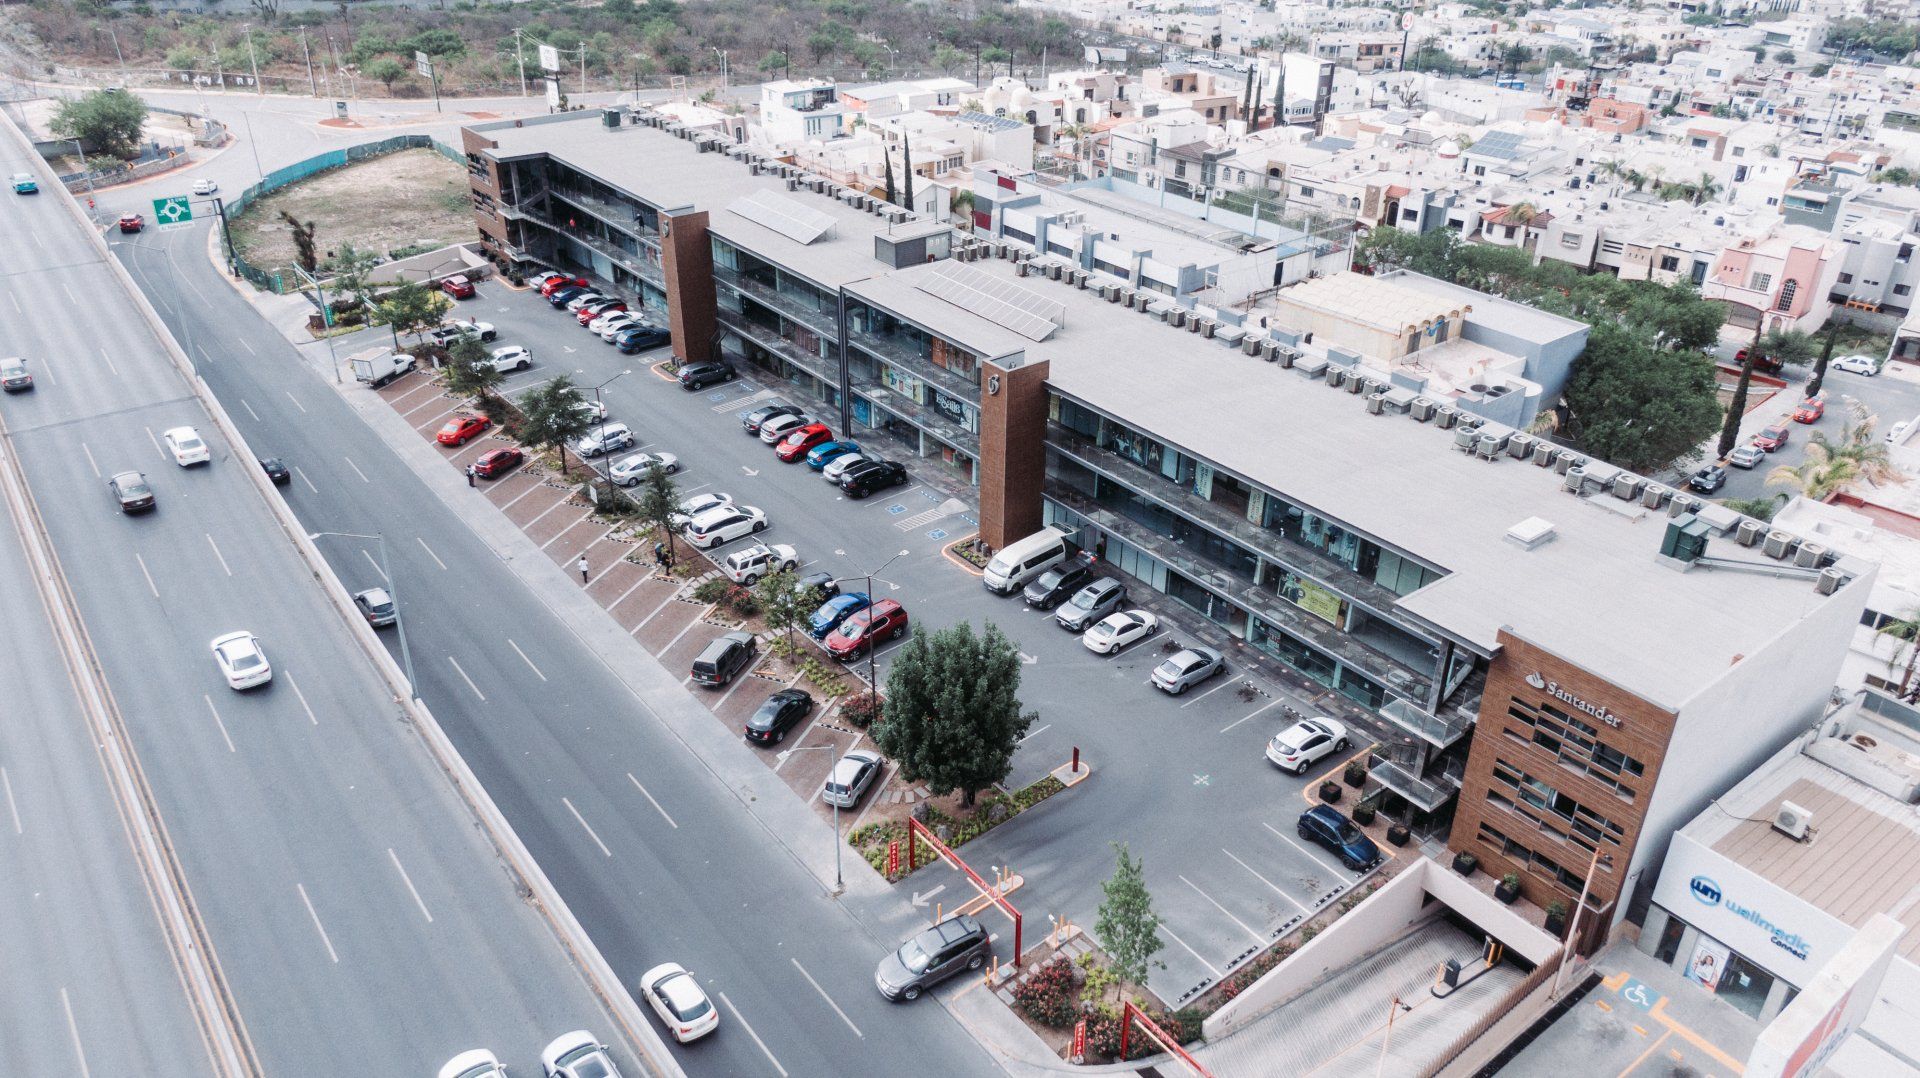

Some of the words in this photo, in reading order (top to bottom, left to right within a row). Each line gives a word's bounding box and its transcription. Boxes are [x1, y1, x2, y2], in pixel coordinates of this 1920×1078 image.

[1546, 681, 1622, 728] Santander
[1725, 899, 1811, 952] wellmedic
[1770, 936, 1807, 961] Connect
